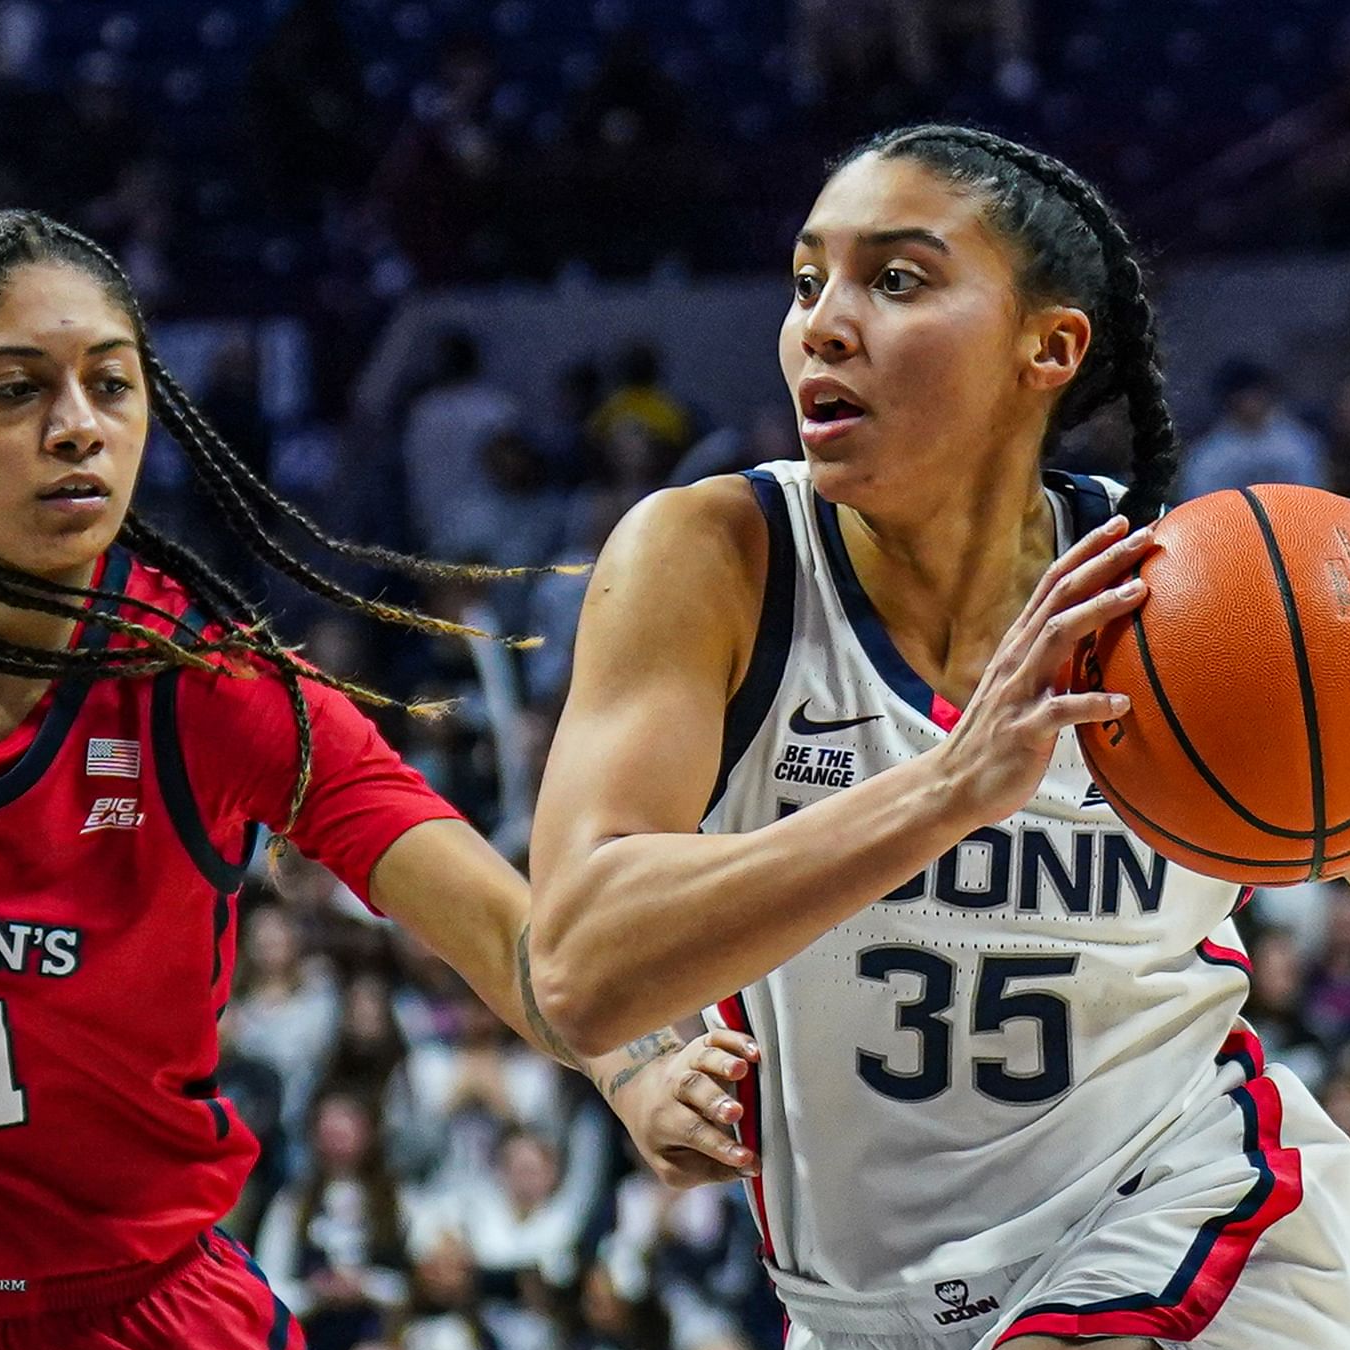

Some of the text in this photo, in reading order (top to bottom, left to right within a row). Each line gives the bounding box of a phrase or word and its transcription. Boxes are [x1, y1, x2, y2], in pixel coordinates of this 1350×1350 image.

[784, 744, 855, 769] BE THE
[774, 762, 855, 788] CHANGE
[91, 797, 138, 812] BIG
[84, 811, 146, 827] EAST
[855, 943, 1081, 1107] 35
[933, 1295, 1000, 1326] UCONN
